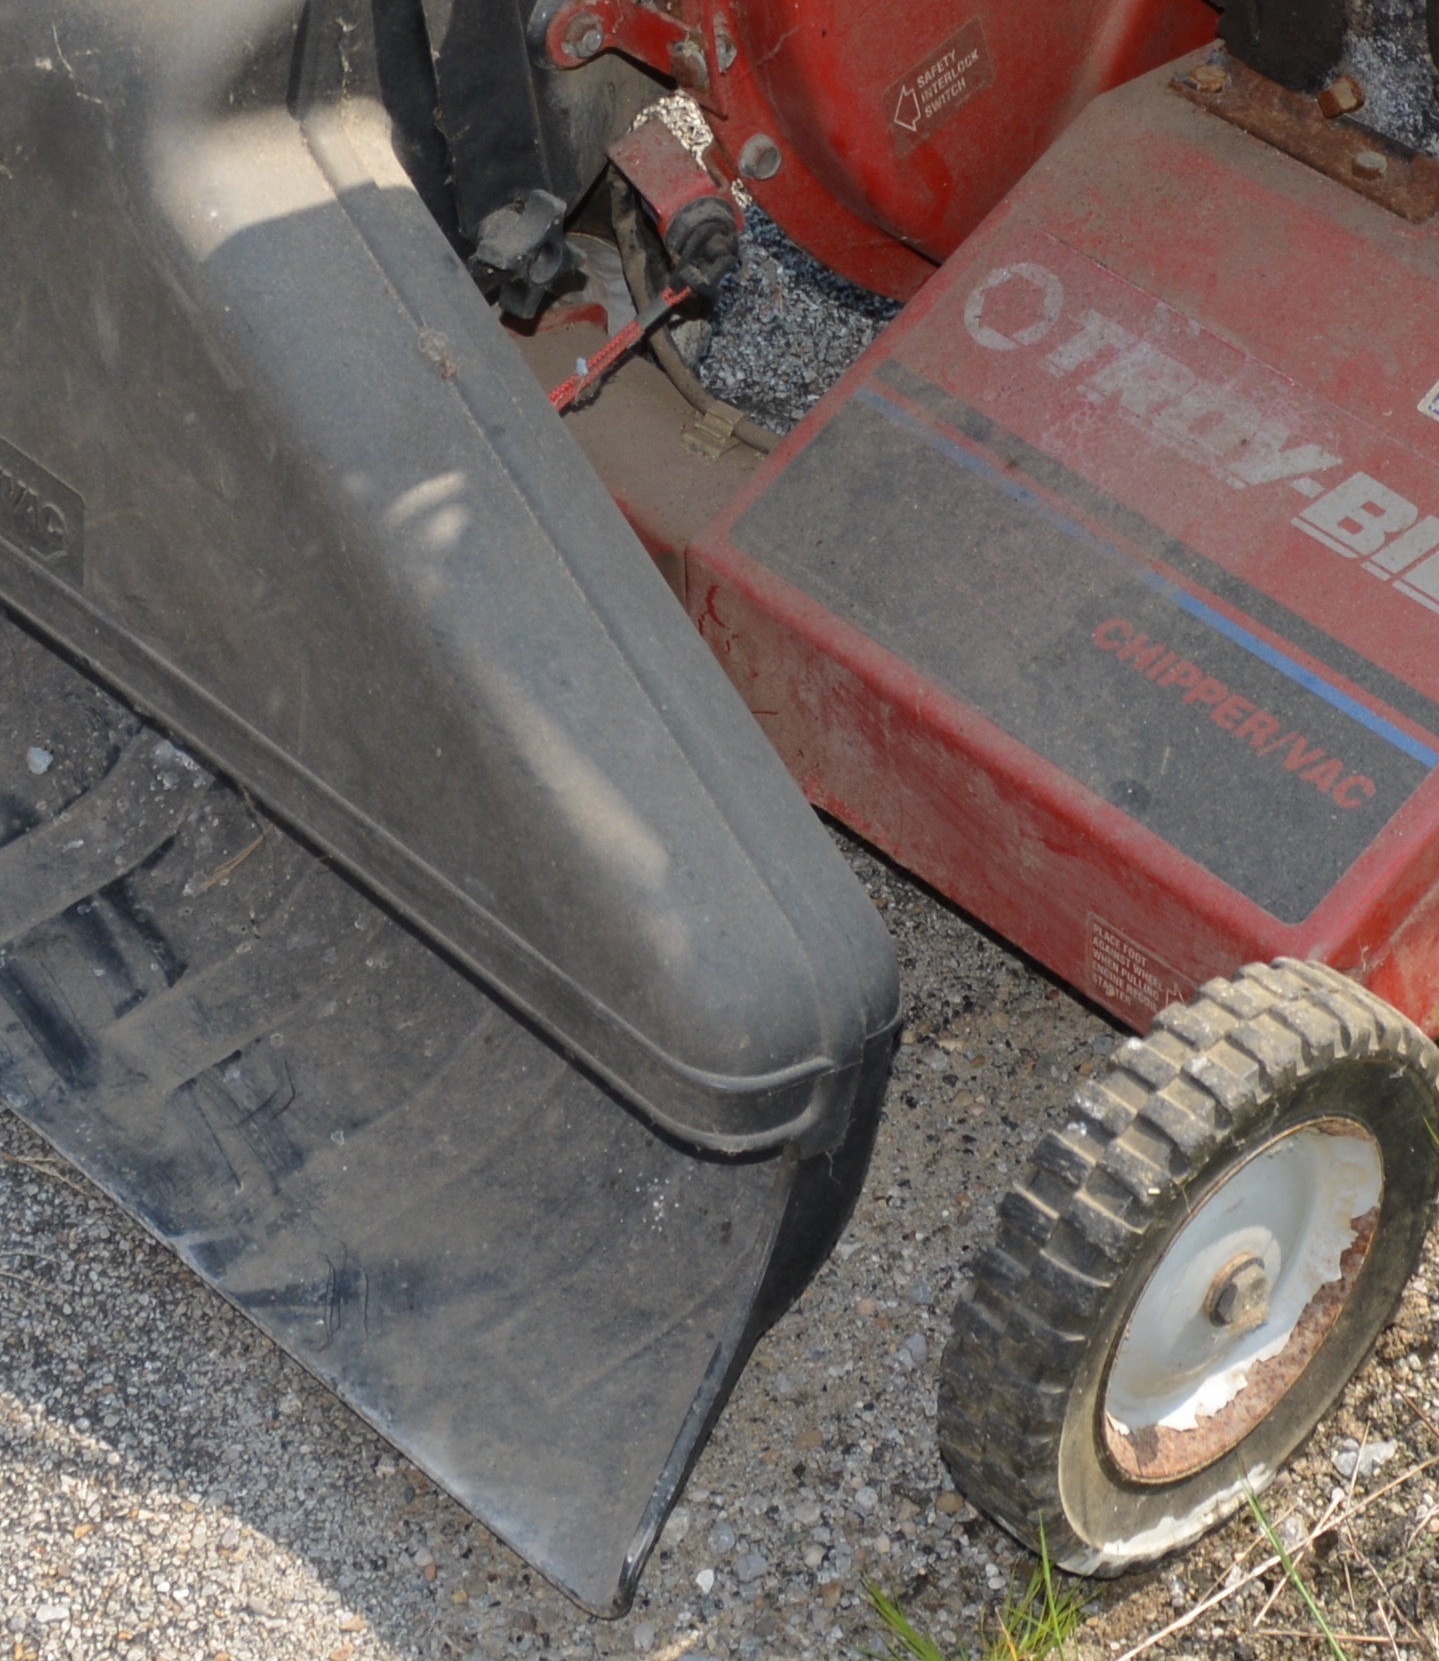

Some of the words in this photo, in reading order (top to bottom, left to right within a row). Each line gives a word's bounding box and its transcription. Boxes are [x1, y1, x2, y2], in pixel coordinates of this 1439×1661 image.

[917, 49, 957, 88] SAFETY
[921, 49, 979, 103] INTERLOCK
[924, 77, 967, 118] SWITCH
[1091, 617, 1377, 810] CHIPPER/VAC
[1093, 924, 1120, 949] PLACE
[1123, 939, 1147, 966] FOOT
[1093, 937, 1131, 970] AGAINST
[1133, 963, 1164, 992] WHEEL
[1092, 961, 1125, 990] ENGINE
[1093, 948, 1119, 973] WHEN
[1121, 967, 1160, 1002] PULLING
